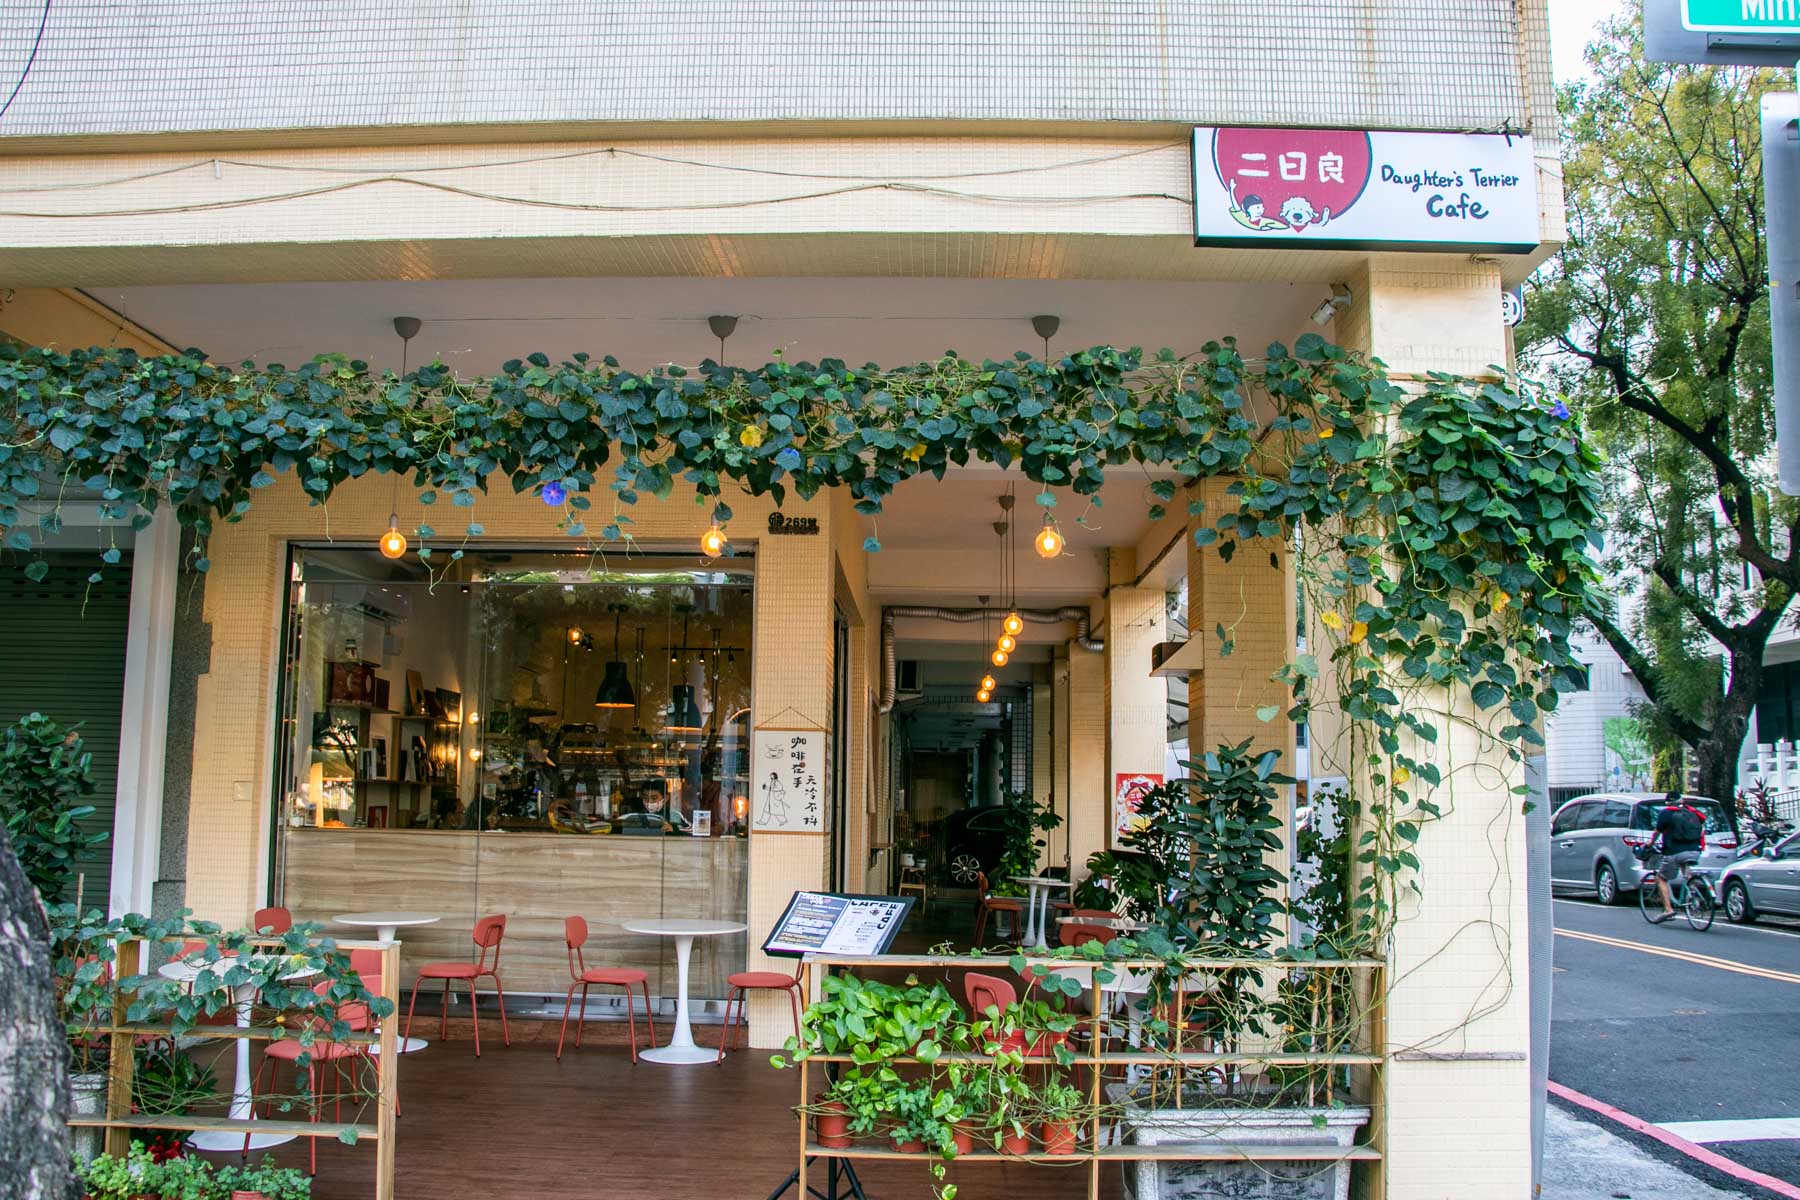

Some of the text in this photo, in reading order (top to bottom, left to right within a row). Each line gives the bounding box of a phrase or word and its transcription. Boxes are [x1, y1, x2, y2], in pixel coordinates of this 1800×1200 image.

[1741, 0, 1800, 21] Min
[1237, 151, 1345, 184] 二日良
[1381, 164, 1520, 193] Daughter's Terrier
[1426, 192, 1489, 219] Cafe
[791, 736, 807, 788] 咖啡在手
